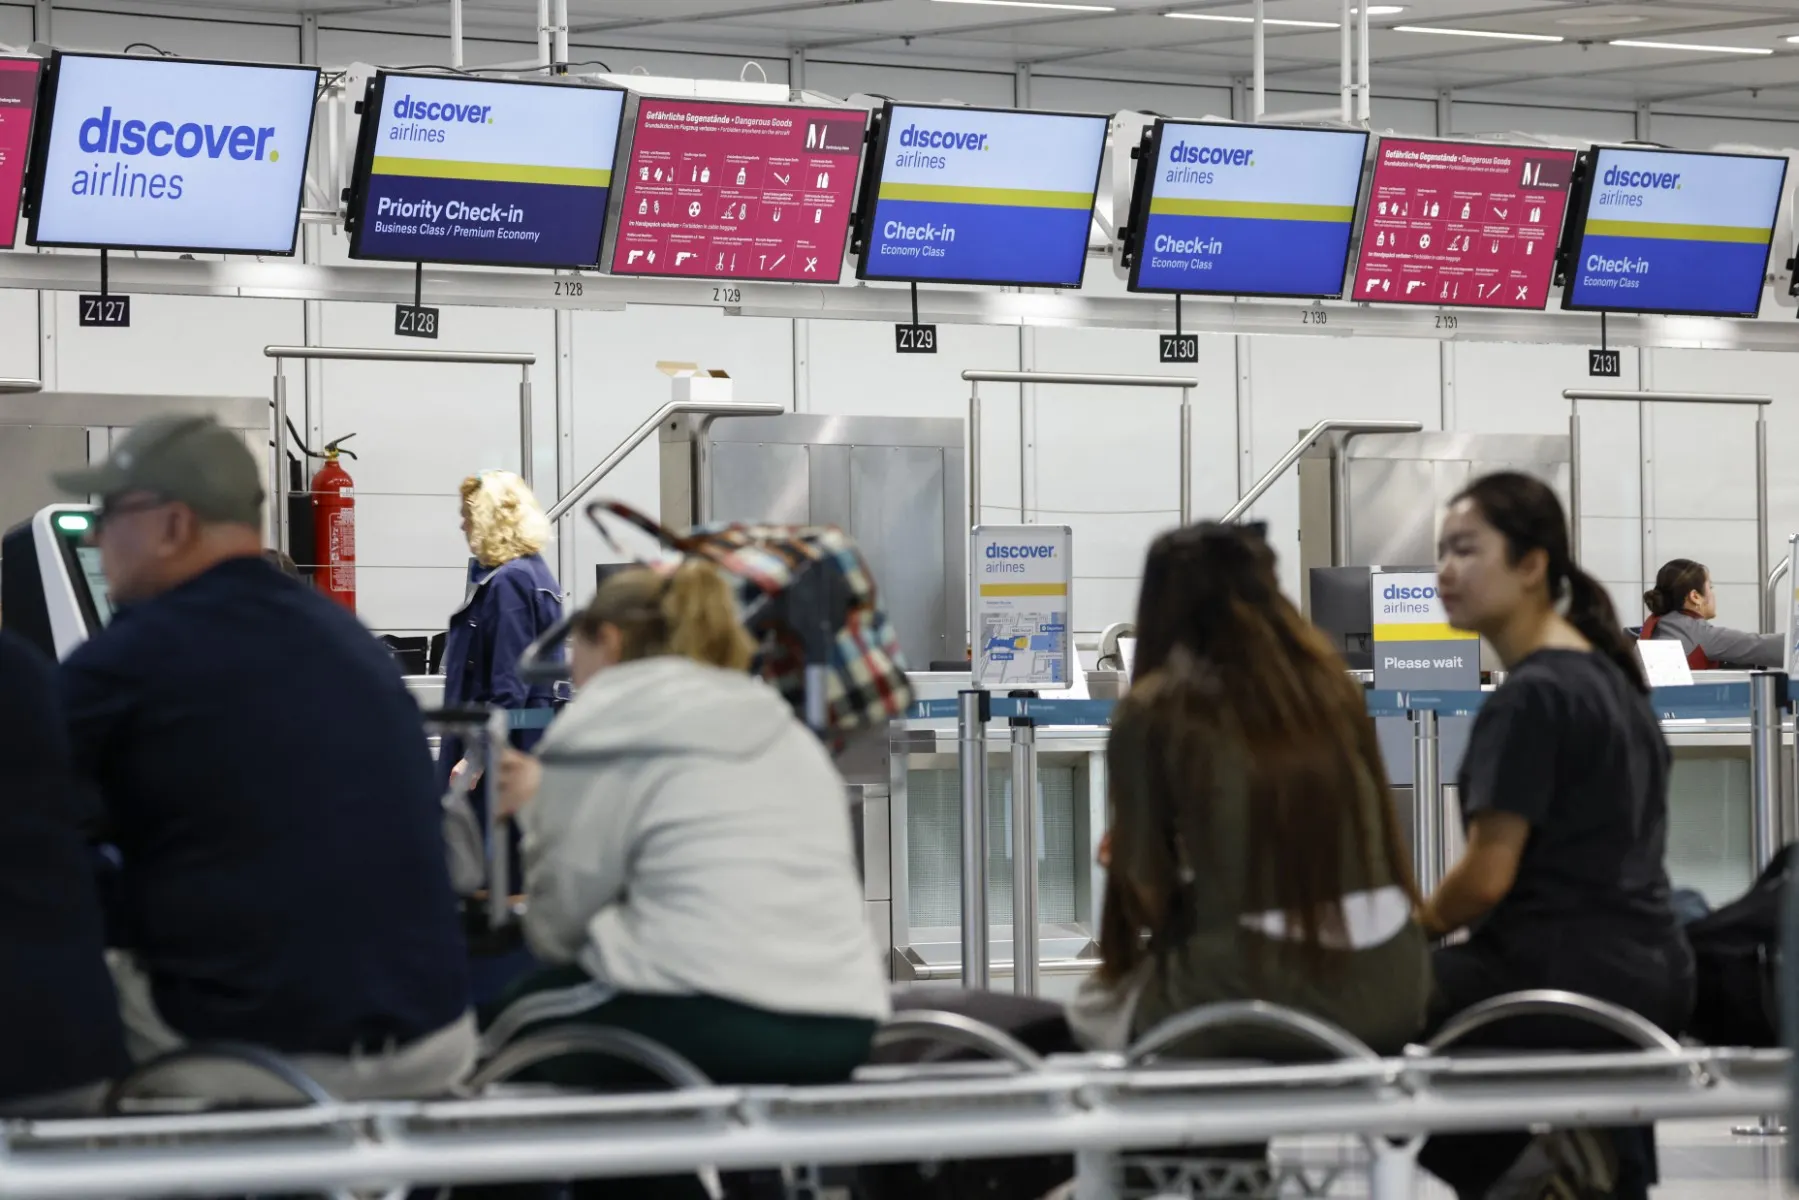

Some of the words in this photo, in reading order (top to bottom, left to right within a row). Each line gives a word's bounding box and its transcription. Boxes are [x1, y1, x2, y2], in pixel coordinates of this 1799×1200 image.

[393, 94, 493, 124] discover.
[646, 111, 685, 122] Gefährliche
[686, 113, 730, 125] Gegenstände
[735, 116, 770, 127] Dangerous
[772, 117, 793, 127] Goods
[79, 106, 279, 162] discover.
[389, 124, 445, 143] airlines
[900, 124, 989, 151] discover.
[896, 151, 946, 169] airlines
[1170, 140, 1255, 166] discover.
[1386, 150, 1419, 160] Gefährliche
[1420, 152, 1457, 163] Gegenstände
[1461, 154, 1492, 165] Dangerous
[1493, 157, 1511, 166] Goods
[72, 162, 184, 199] airlines
[1166, 167, 1214, 184] airlines
[1603, 165, 1681, 190] discover.
[1599, 190, 1643, 207] airlines
[377, 197, 443, 222] Priority
[446, 201, 523, 223] Check-in
[375, 221, 417, 234] Business
[419, 223, 445, 236] Class
[453, 225, 495, 238] Premium
[497, 228, 540, 242] Economy
[884, 220, 955, 242] Check-in
[881, 244, 921, 258] Economy
[922, 246, 945, 257] Class
[1154, 234, 1222, 255] Check-in
[1152, 257, 1189, 271] Economy
[1190, 259, 1213, 270] Class
[1586, 254, 1649, 274] Check-in
[554, 282, 561, 296] Z
[565, 282, 583, 297] 128
[1584, 276, 1618, 289] Economy
[1619, 278, 1640, 288] Class
[713, 288, 720, 302] Z
[723, 288, 741, 302] 129
[84, 300, 125, 321] Z127
[1311, 311, 1327, 325] 130
[399, 310, 435, 333] Z128
[1443, 316, 1458, 329] 131
[899, 329, 933, 348] Z129
[1163, 339, 1195, 358] Z130
[1592, 353, 1618, 373] Z131
[986, 542, 1058, 559] discover.
[986, 561, 1025, 574] airlines
[1383, 602, 1430, 614] airlines
[1384, 657, 1431, 669] Please
[1432, 655, 1463, 669] wait
